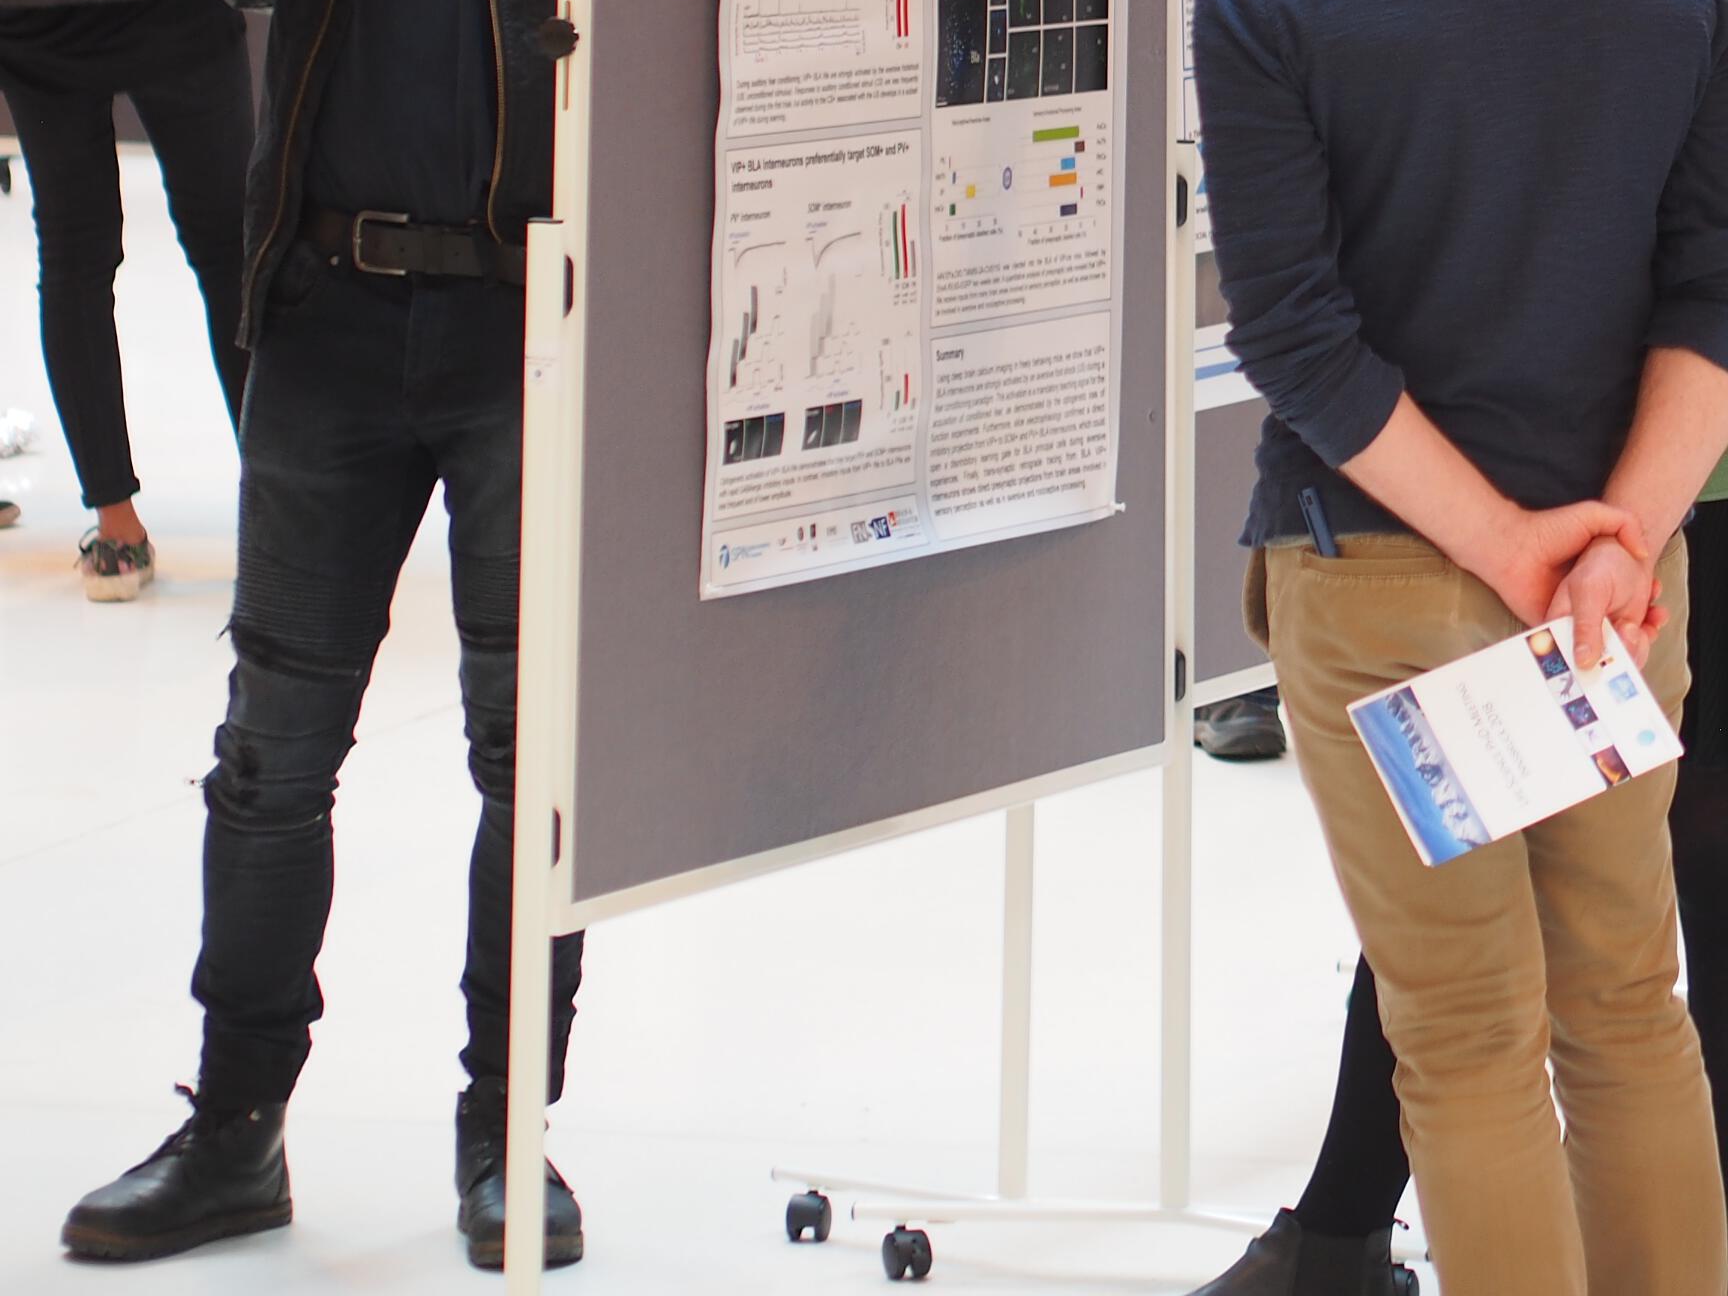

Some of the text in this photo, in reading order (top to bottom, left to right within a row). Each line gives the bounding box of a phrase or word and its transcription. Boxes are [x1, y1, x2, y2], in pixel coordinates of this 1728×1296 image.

[730, 160, 745, 173] VIP+
[747, 158, 760, 171] BLA
[762, 154, 803, 170] interneurons
[805, 150, 845, 168] preferentially
[847, 148, 864, 163] target
[885, 145, 896, 156] and
[730, 180, 774, 191] interneurons
[936, 347, 964, 363] Summary
